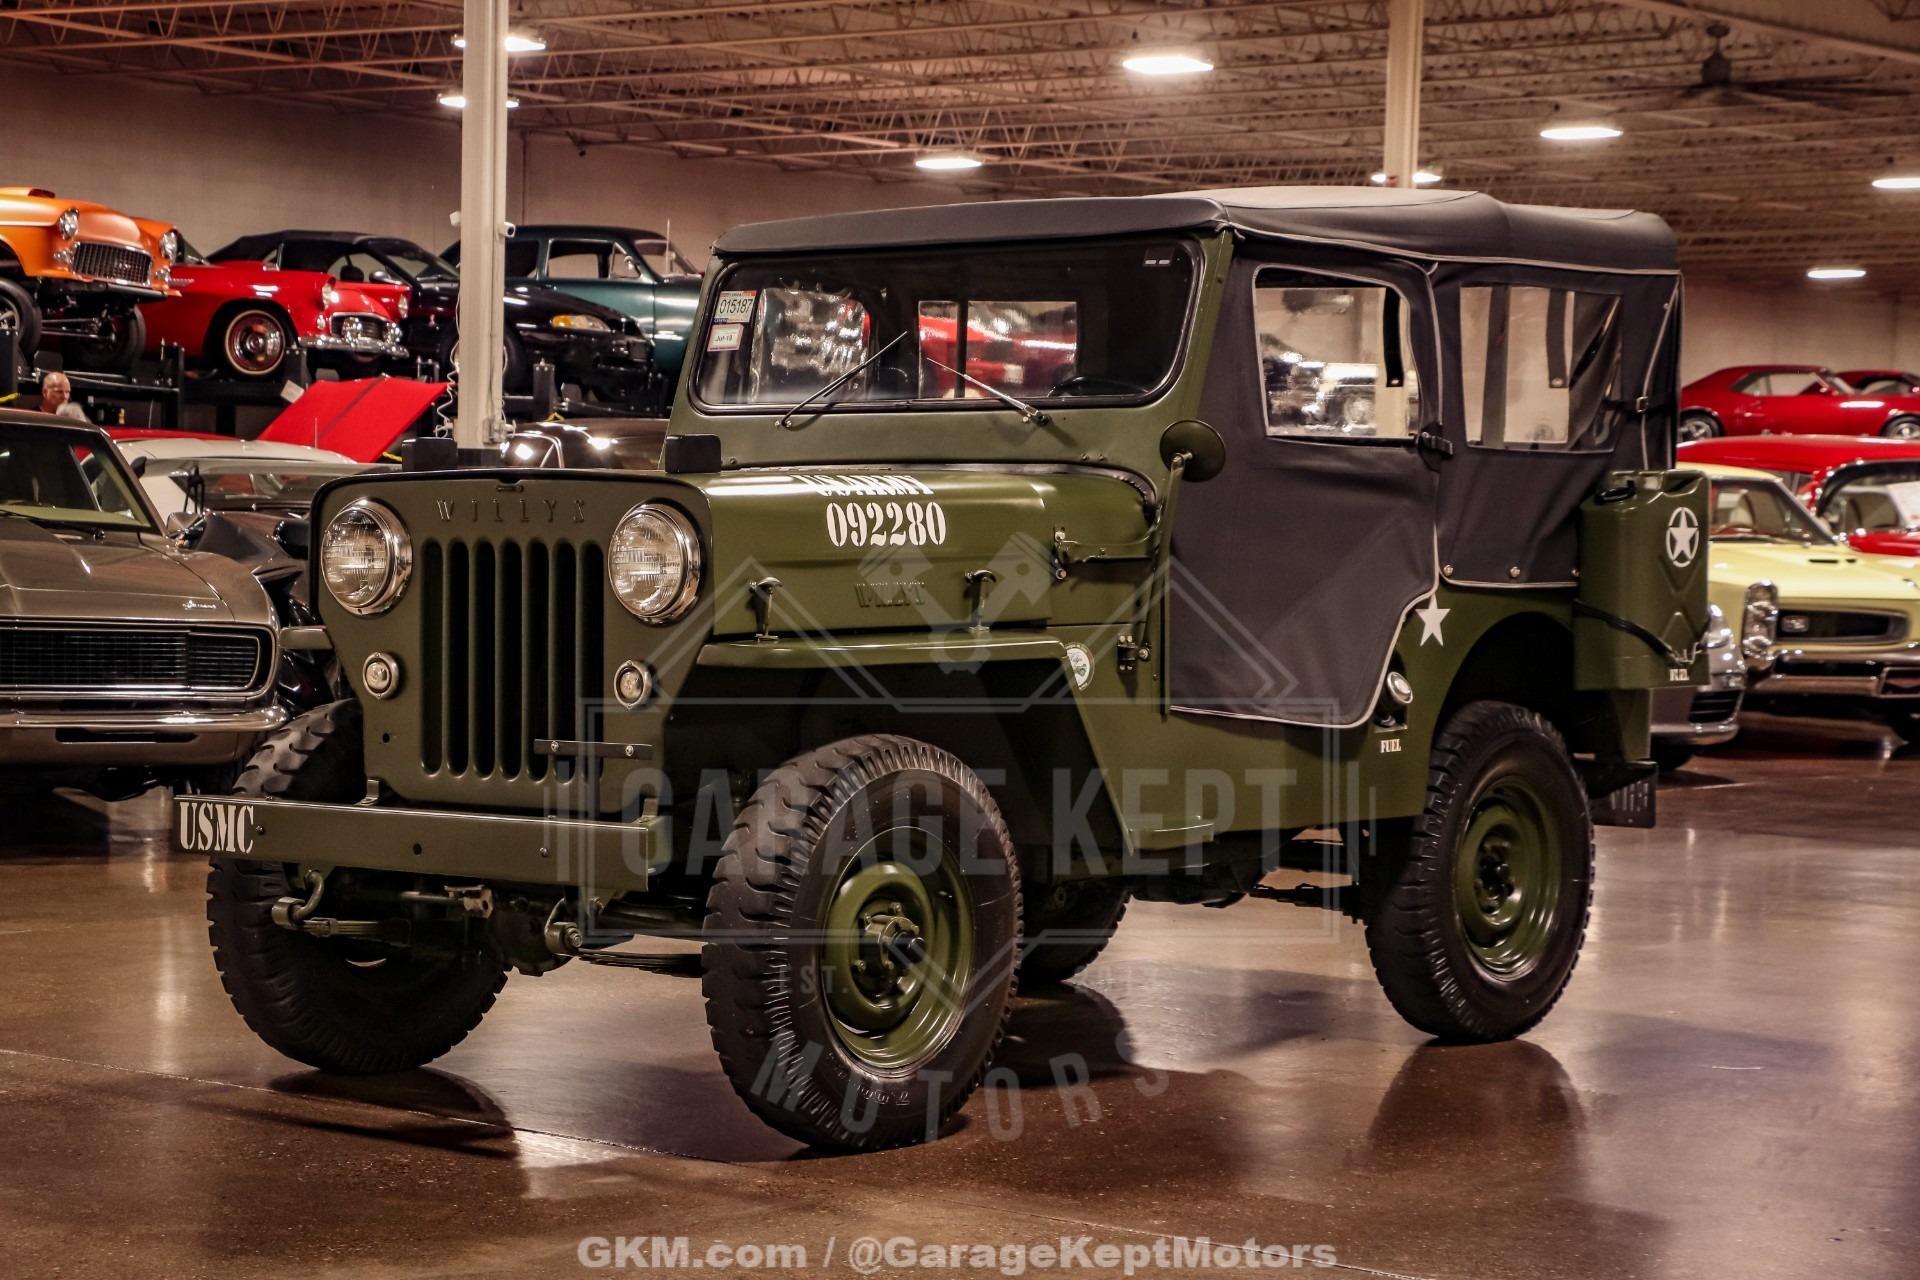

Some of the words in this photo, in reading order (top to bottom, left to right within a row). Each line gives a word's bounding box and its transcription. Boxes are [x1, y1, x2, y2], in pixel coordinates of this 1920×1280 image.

[720, 298, 753, 314] 015187
[435, 499, 585, 524] WILLYS
[826, 501, 947, 547] 092280
[1380, 738, 1402, 753] FUEL
[180, 802, 254, 854] USMC
